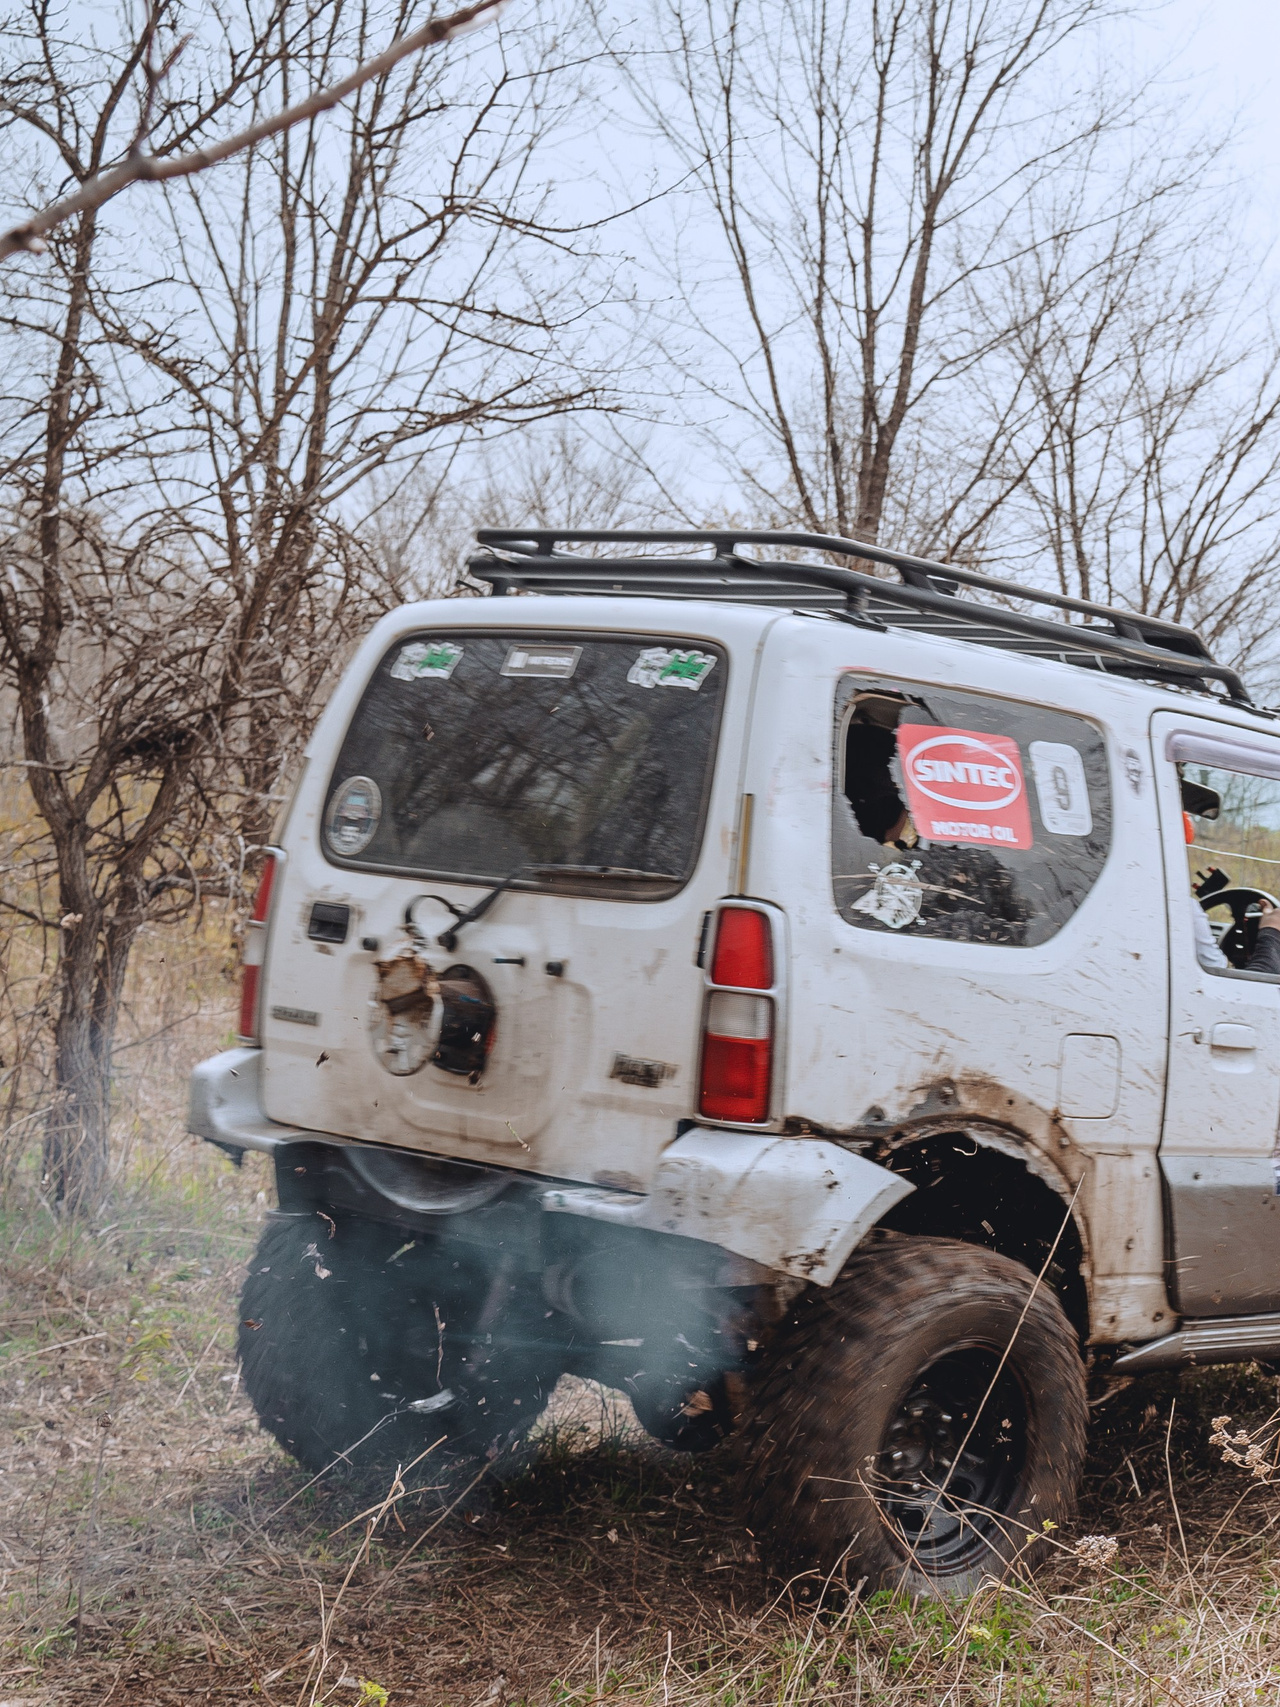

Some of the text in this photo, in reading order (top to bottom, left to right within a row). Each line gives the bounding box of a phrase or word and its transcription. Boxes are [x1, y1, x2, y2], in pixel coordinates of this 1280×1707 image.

[913, 760, 1015, 789] SINTEC
[930, 820, 1019, 843] MOTOR OIL
